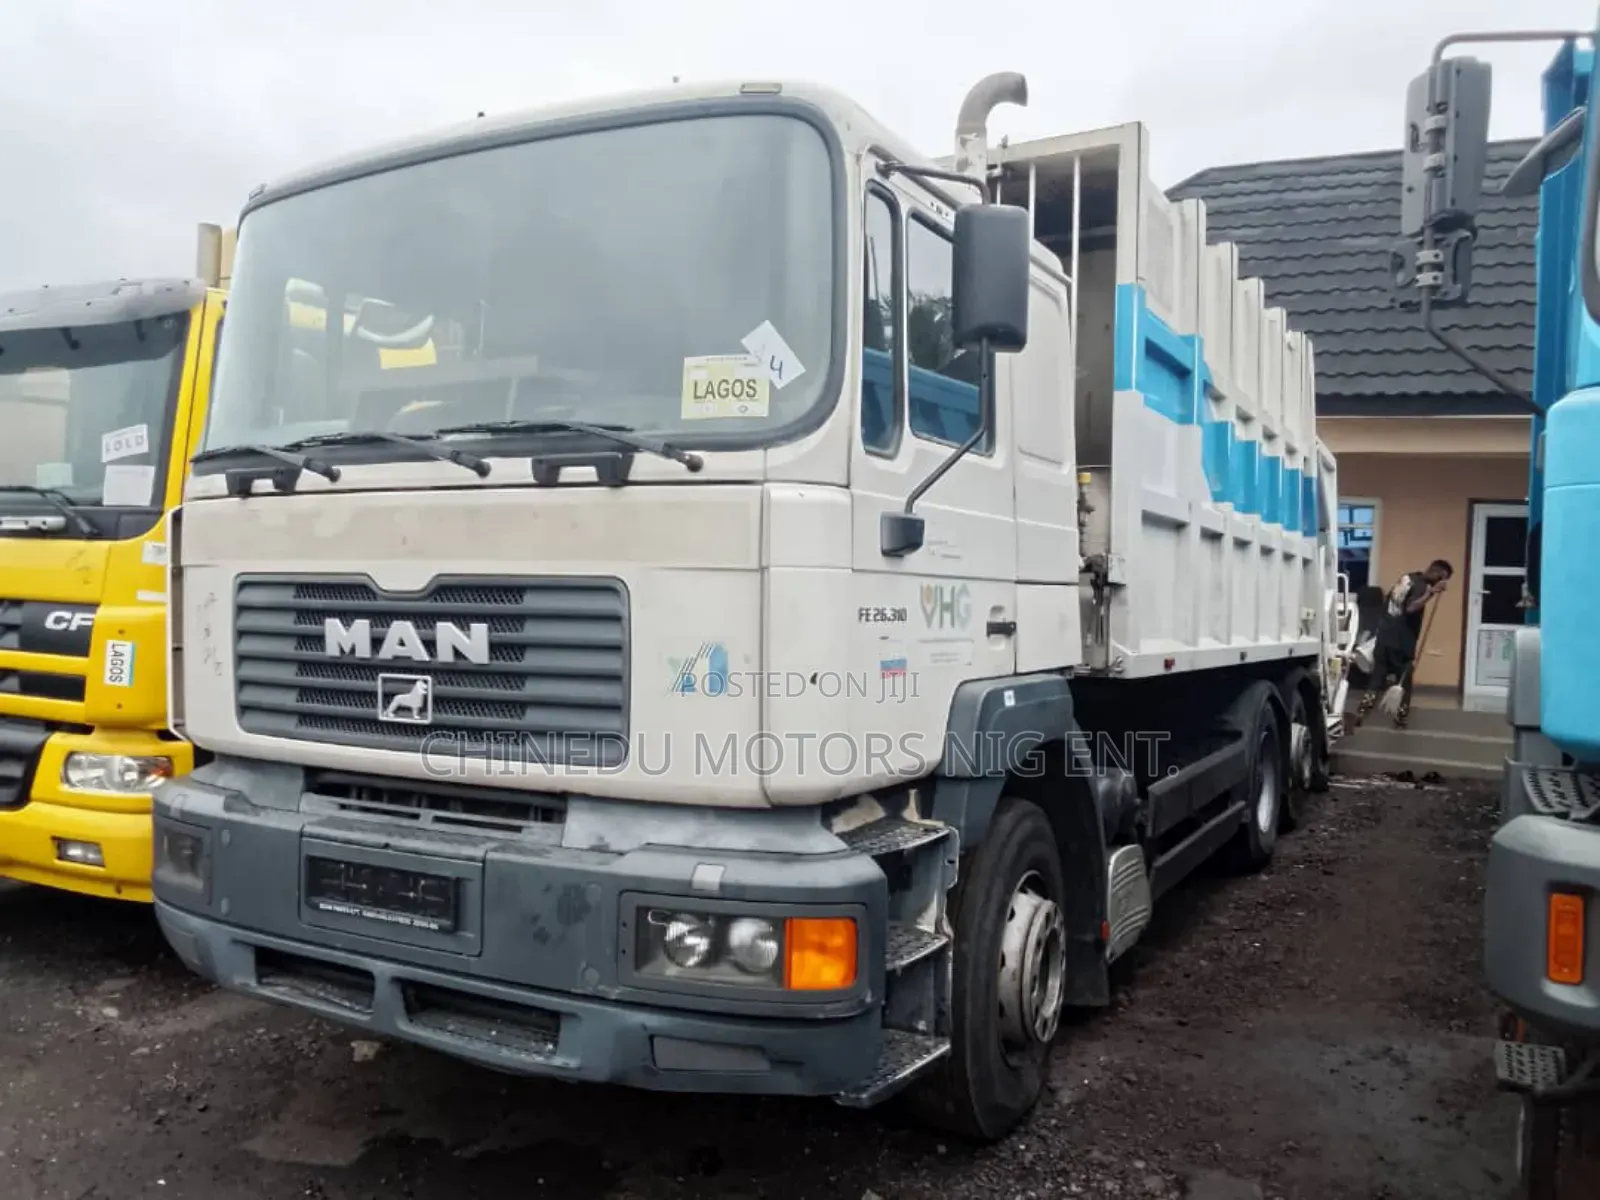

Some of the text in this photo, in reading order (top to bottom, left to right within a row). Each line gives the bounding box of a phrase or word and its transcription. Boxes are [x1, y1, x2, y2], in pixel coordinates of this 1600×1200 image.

[693, 379, 757, 400] LAGOS
[44, 611, 96, 631] CF
[324, 617, 490, 665] MAN
[108, 642, 126, 684] LAGOS
